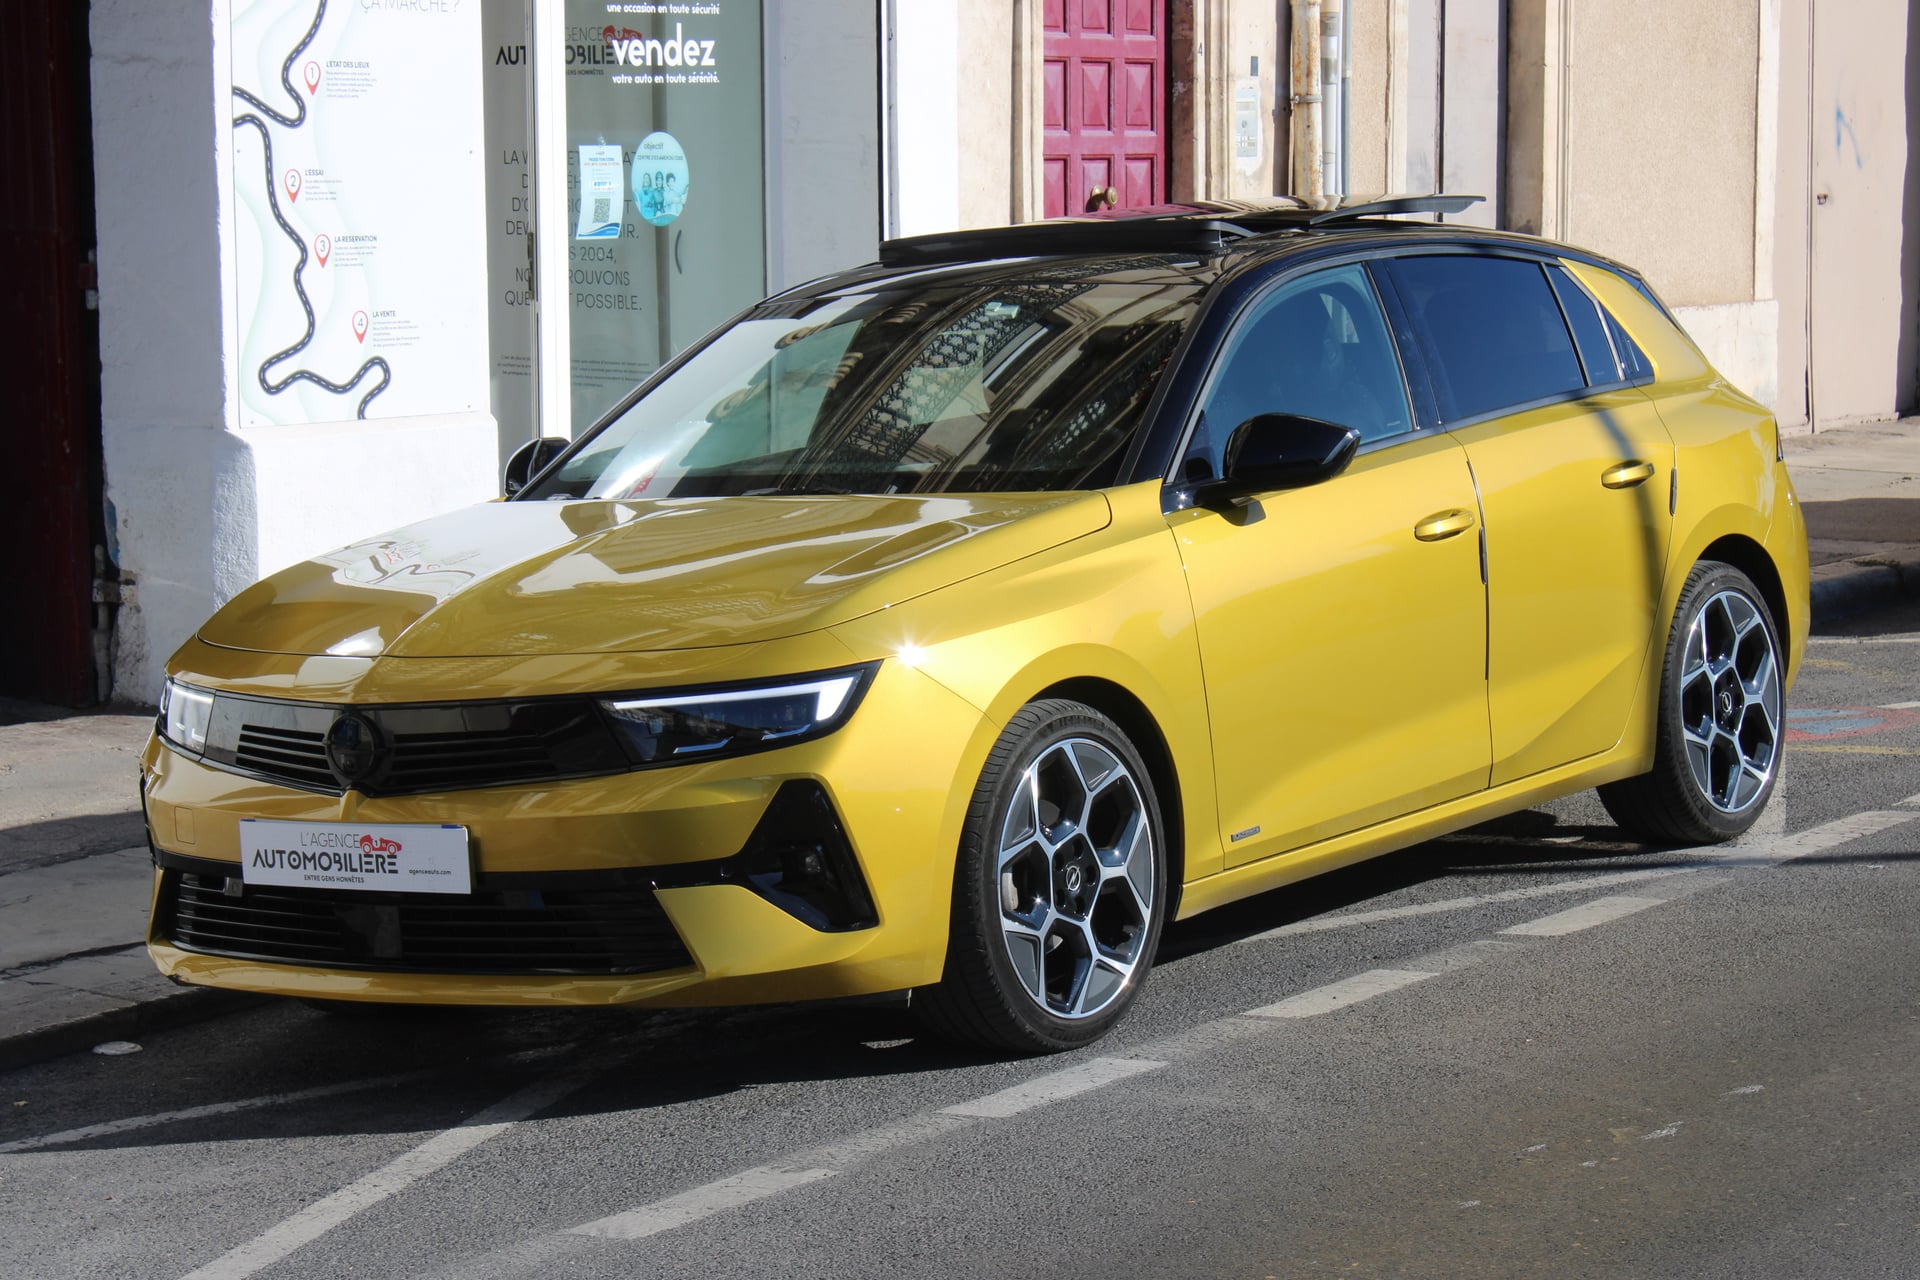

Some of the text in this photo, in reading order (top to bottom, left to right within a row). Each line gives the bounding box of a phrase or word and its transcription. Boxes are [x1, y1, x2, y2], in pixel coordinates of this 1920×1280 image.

[606, 4, 621, 13] une
[623, 2, 656, 13] occasion
[658, 5, 668, 13] en
[669, 3, 690, 14] toute
[612, 22, 716, 67] vendez
[612, 71, 720, 84] votre auto en toute sérénité.
[290, 175, 297, 187] 2
[319, 240, 326, 252] 3
[580, 246, 617, 264] 2004,
[576, 292, 642, 311] POSSIBLE.
[357, 317, 364, 327] 4
[300, 832, 360, 849] L'AGENCE
[304, 874, 320, 882] ENTRE
[408, 868, 452, 876] agenceauto.com
